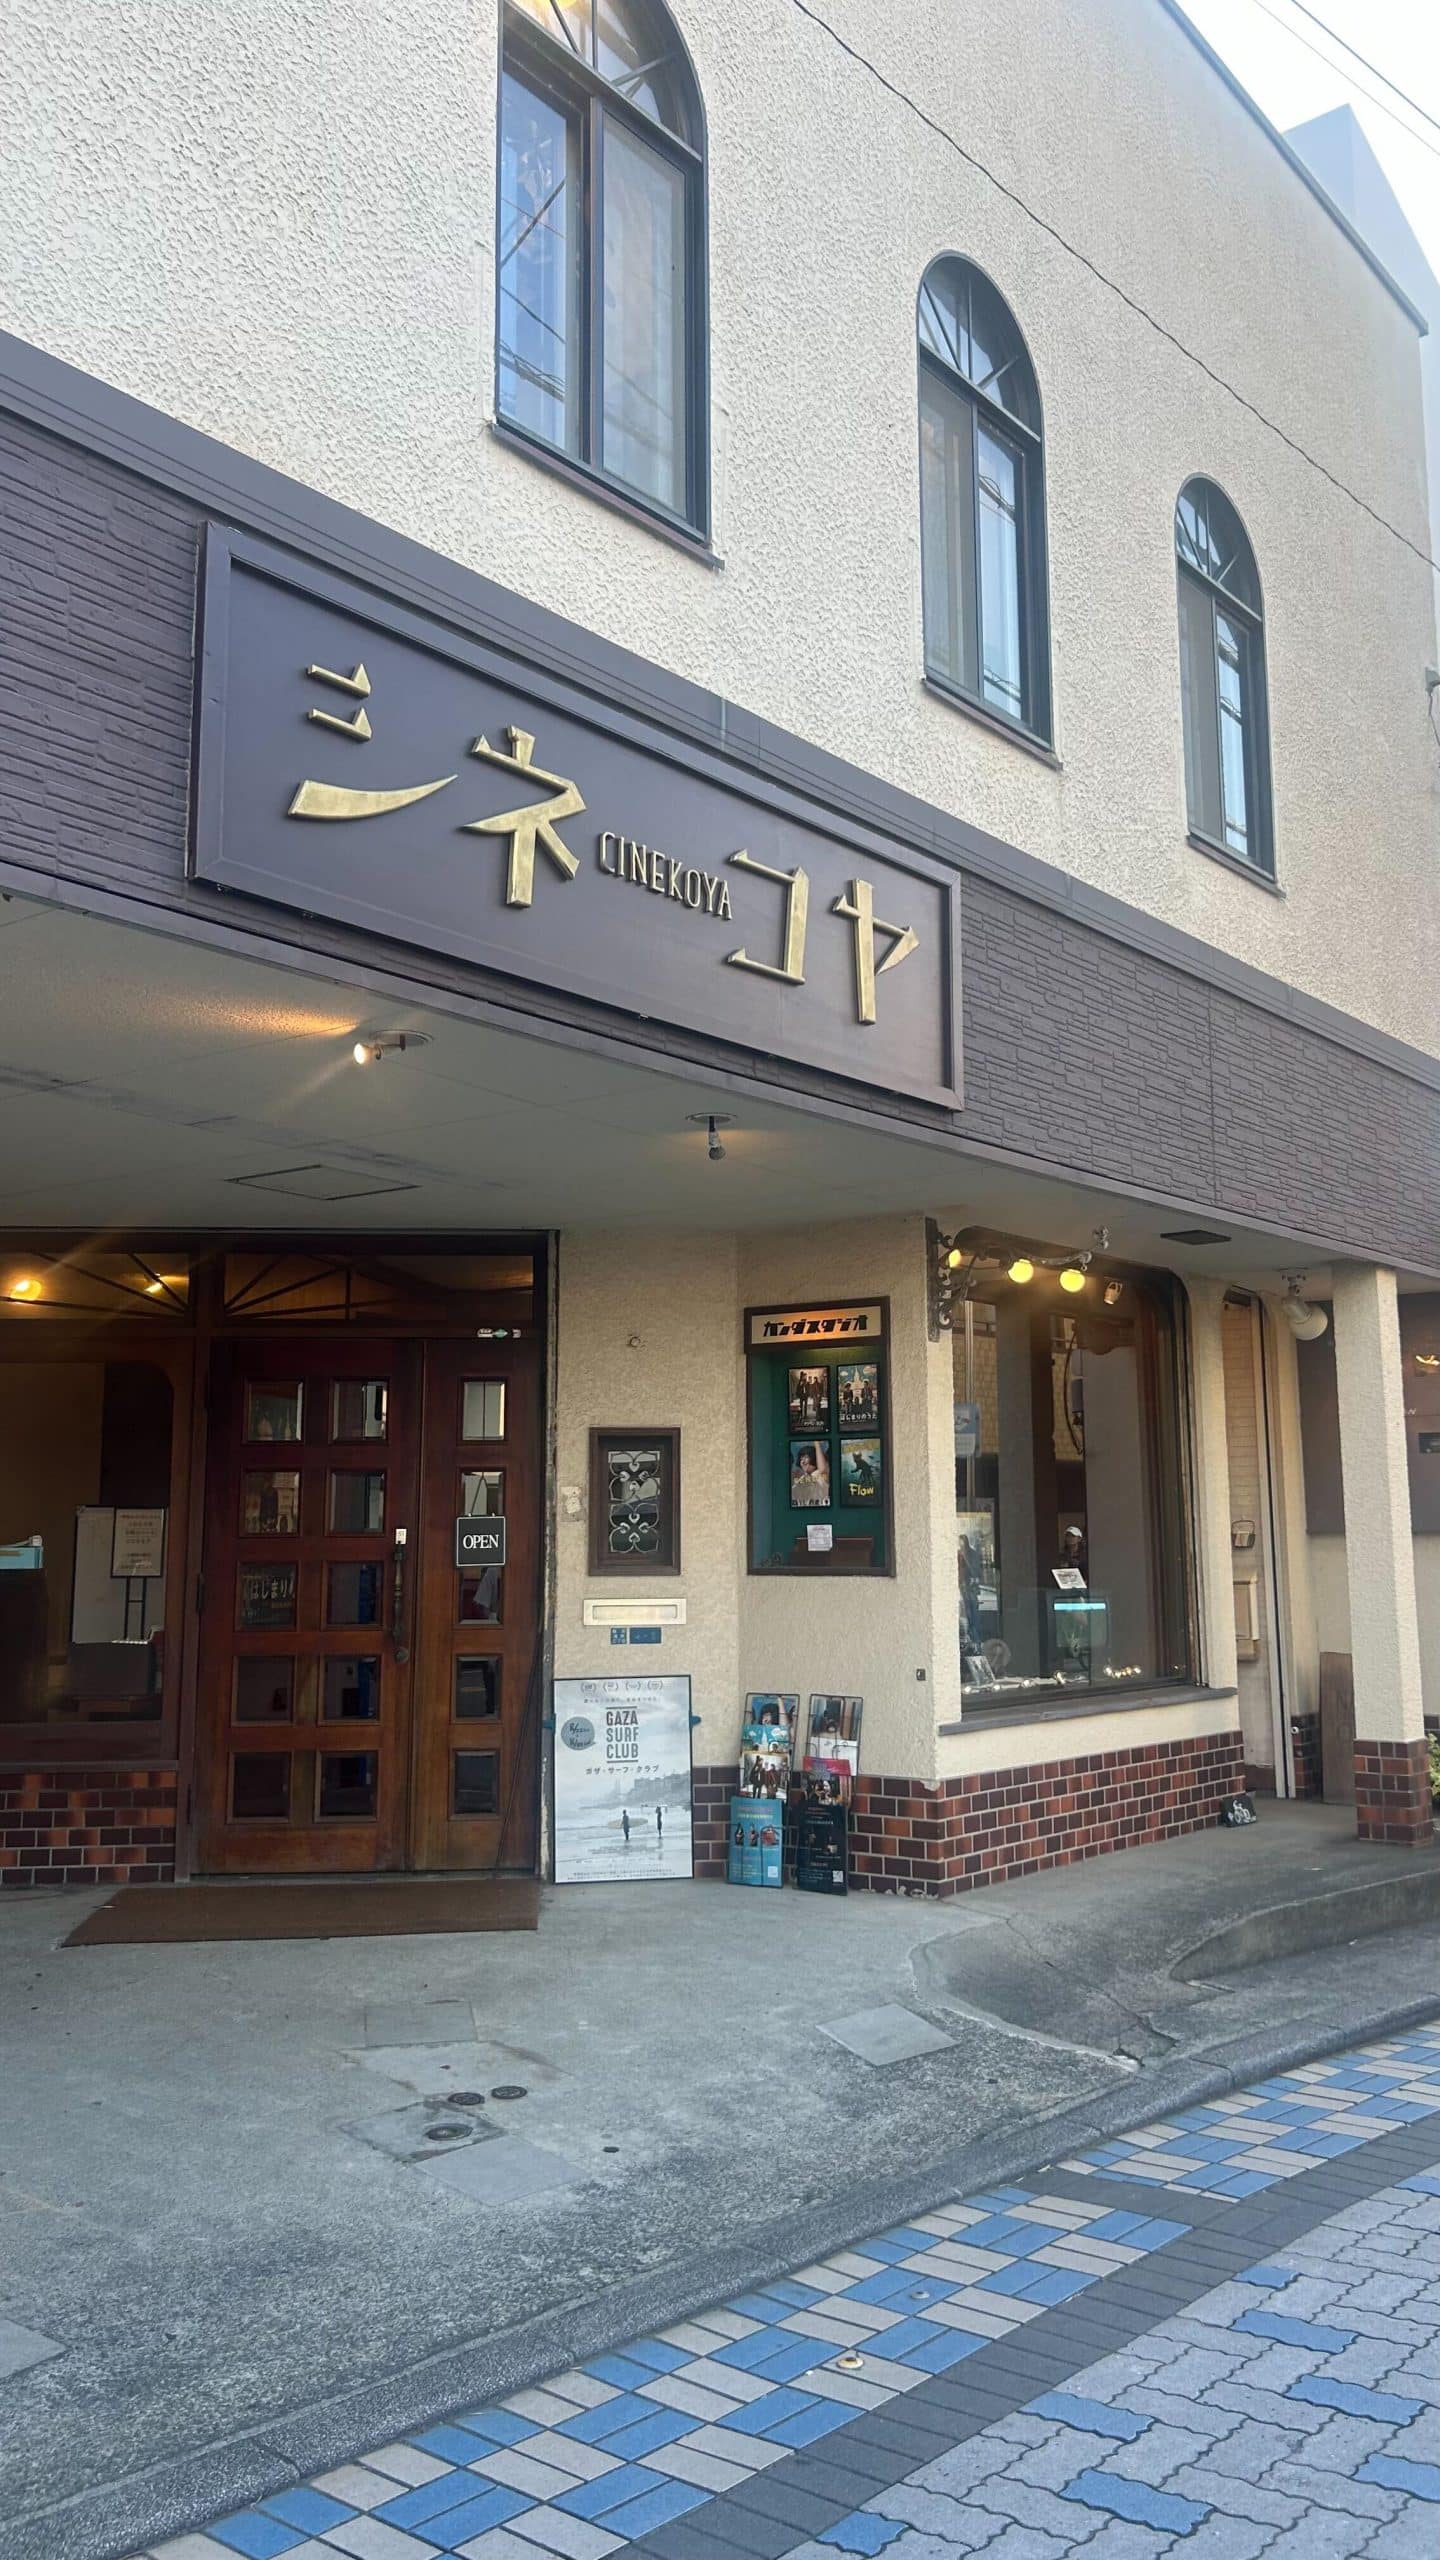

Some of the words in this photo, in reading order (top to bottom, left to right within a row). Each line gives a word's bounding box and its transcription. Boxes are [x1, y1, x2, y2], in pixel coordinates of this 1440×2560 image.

[288, 662, 587, 907] シネ
[600, 831, 733, 920] CINEKOYA
[727, 848, 920, 1025] コヤ
[849, 1483, 874, 1496] Flow
[463, 1534, 499, 1549] OPEN
[606, 1710, 639, 1726] GAZA
[606, 1727, 639, 1743] SURF
[606, 1743, 639, 1759] CLUB
